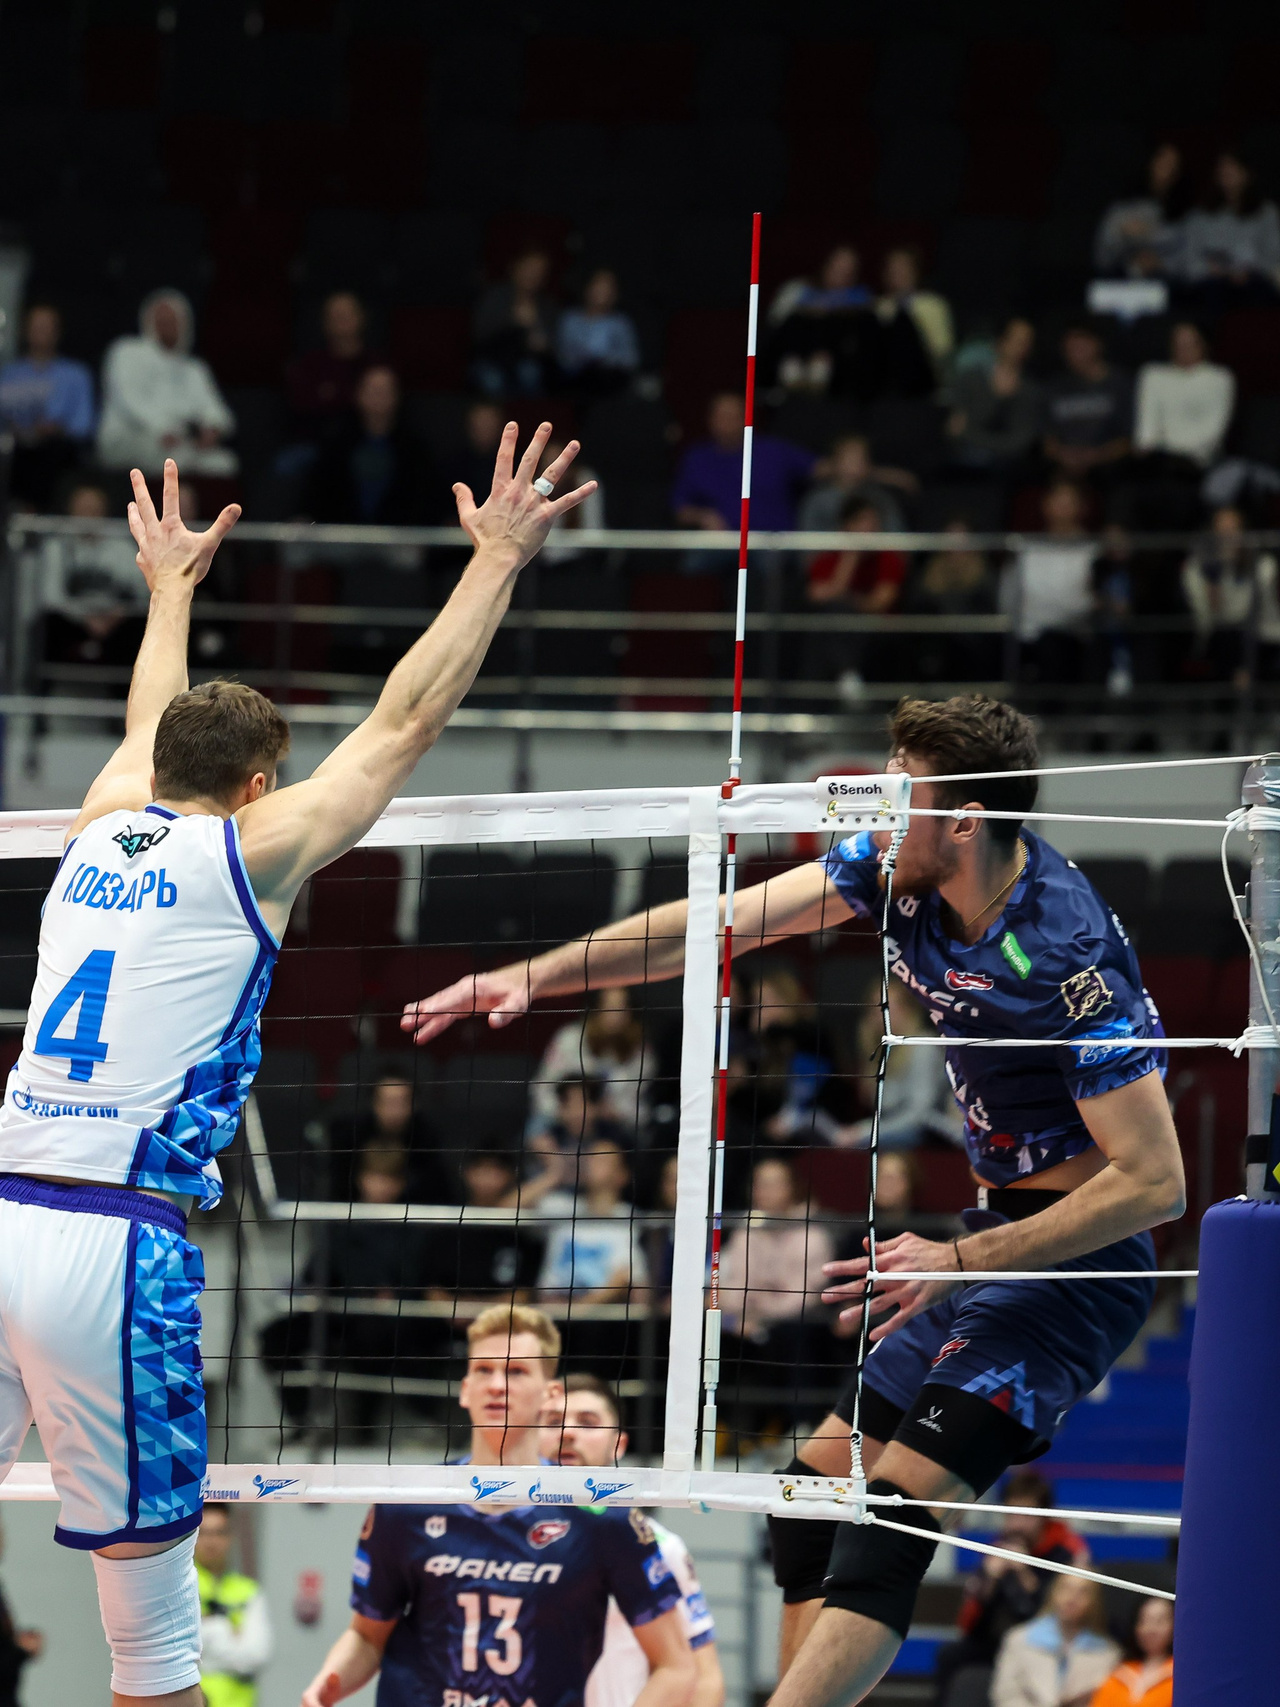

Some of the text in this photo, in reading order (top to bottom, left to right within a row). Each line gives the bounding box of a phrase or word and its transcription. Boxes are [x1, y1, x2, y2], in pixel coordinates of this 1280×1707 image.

[840, 784, 882, 795] Senoh
[33, 950, 116, 1082] 4
[424, 1554, 563, 1584] ФАКЕЛ
[457, 1593, 523, 1676] 13
